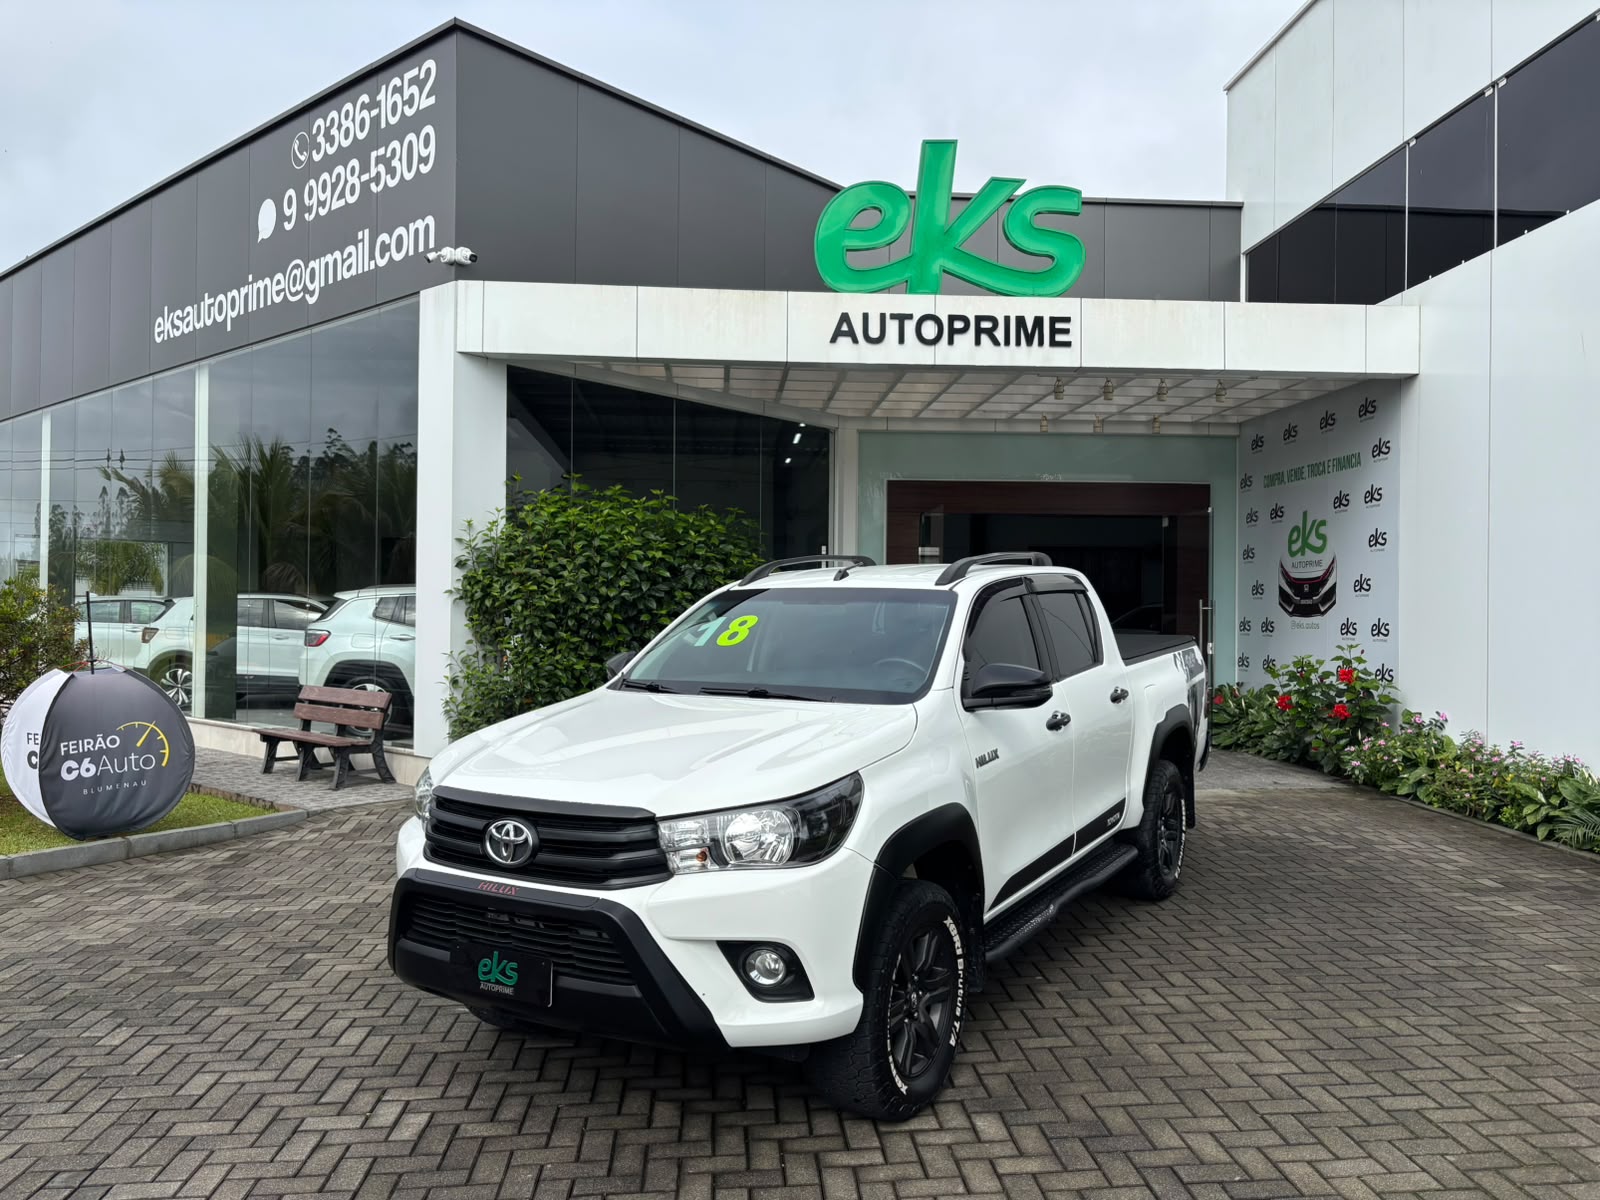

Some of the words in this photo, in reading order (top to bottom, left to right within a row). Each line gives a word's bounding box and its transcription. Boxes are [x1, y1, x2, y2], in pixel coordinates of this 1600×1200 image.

[312, 59, 437, 162] 3386-1652
[283, 189, 297, 231] 9
[303, 124, 437, 222] 9928-5309
[814, 139, 1087, 297] eks
[153, 214, 436, 344] eksautoprime@gmail.com
[829, 312, 1072, 348] AUTOPRIME
[1358, 397, 1377, 418] eks
[1320, 410, 1336, 430] eks
[1283, 422, 1298, 441] eks
[1372, 437, 1391, 458] eks
[1307, 460, 1326, 479] TROCA
[1327, 459, 1332, 474] E
[1332, 452, 1362, 473] FINANCIA
[1333, 490, 1350, 509] eks
[1364, 483, 1382, 504] eks
[1270, 502, 1284, 520] eks
[1287, 510, 1328, 558] eks
[1368, 528, 1388, 548] eks
[1291, 559, 1323, 569] AUTOPRIME
[1353, 573, 1371, 592] eks
[694, 615, 759, 647] 18
[1261, 616, 1275, 633] eks
[1340, 617, 1357, 636] eks
[1370, 617, 1390, 637] eks
[1375, 663, 1394, 682] eks
[60, 734, 120, 756] FEIRÃO
[83, 780, 147, 795] BLUMENAU
[478, 950, 519, 986] eks
[479, 981, 515, 996] AUTOPRIME
